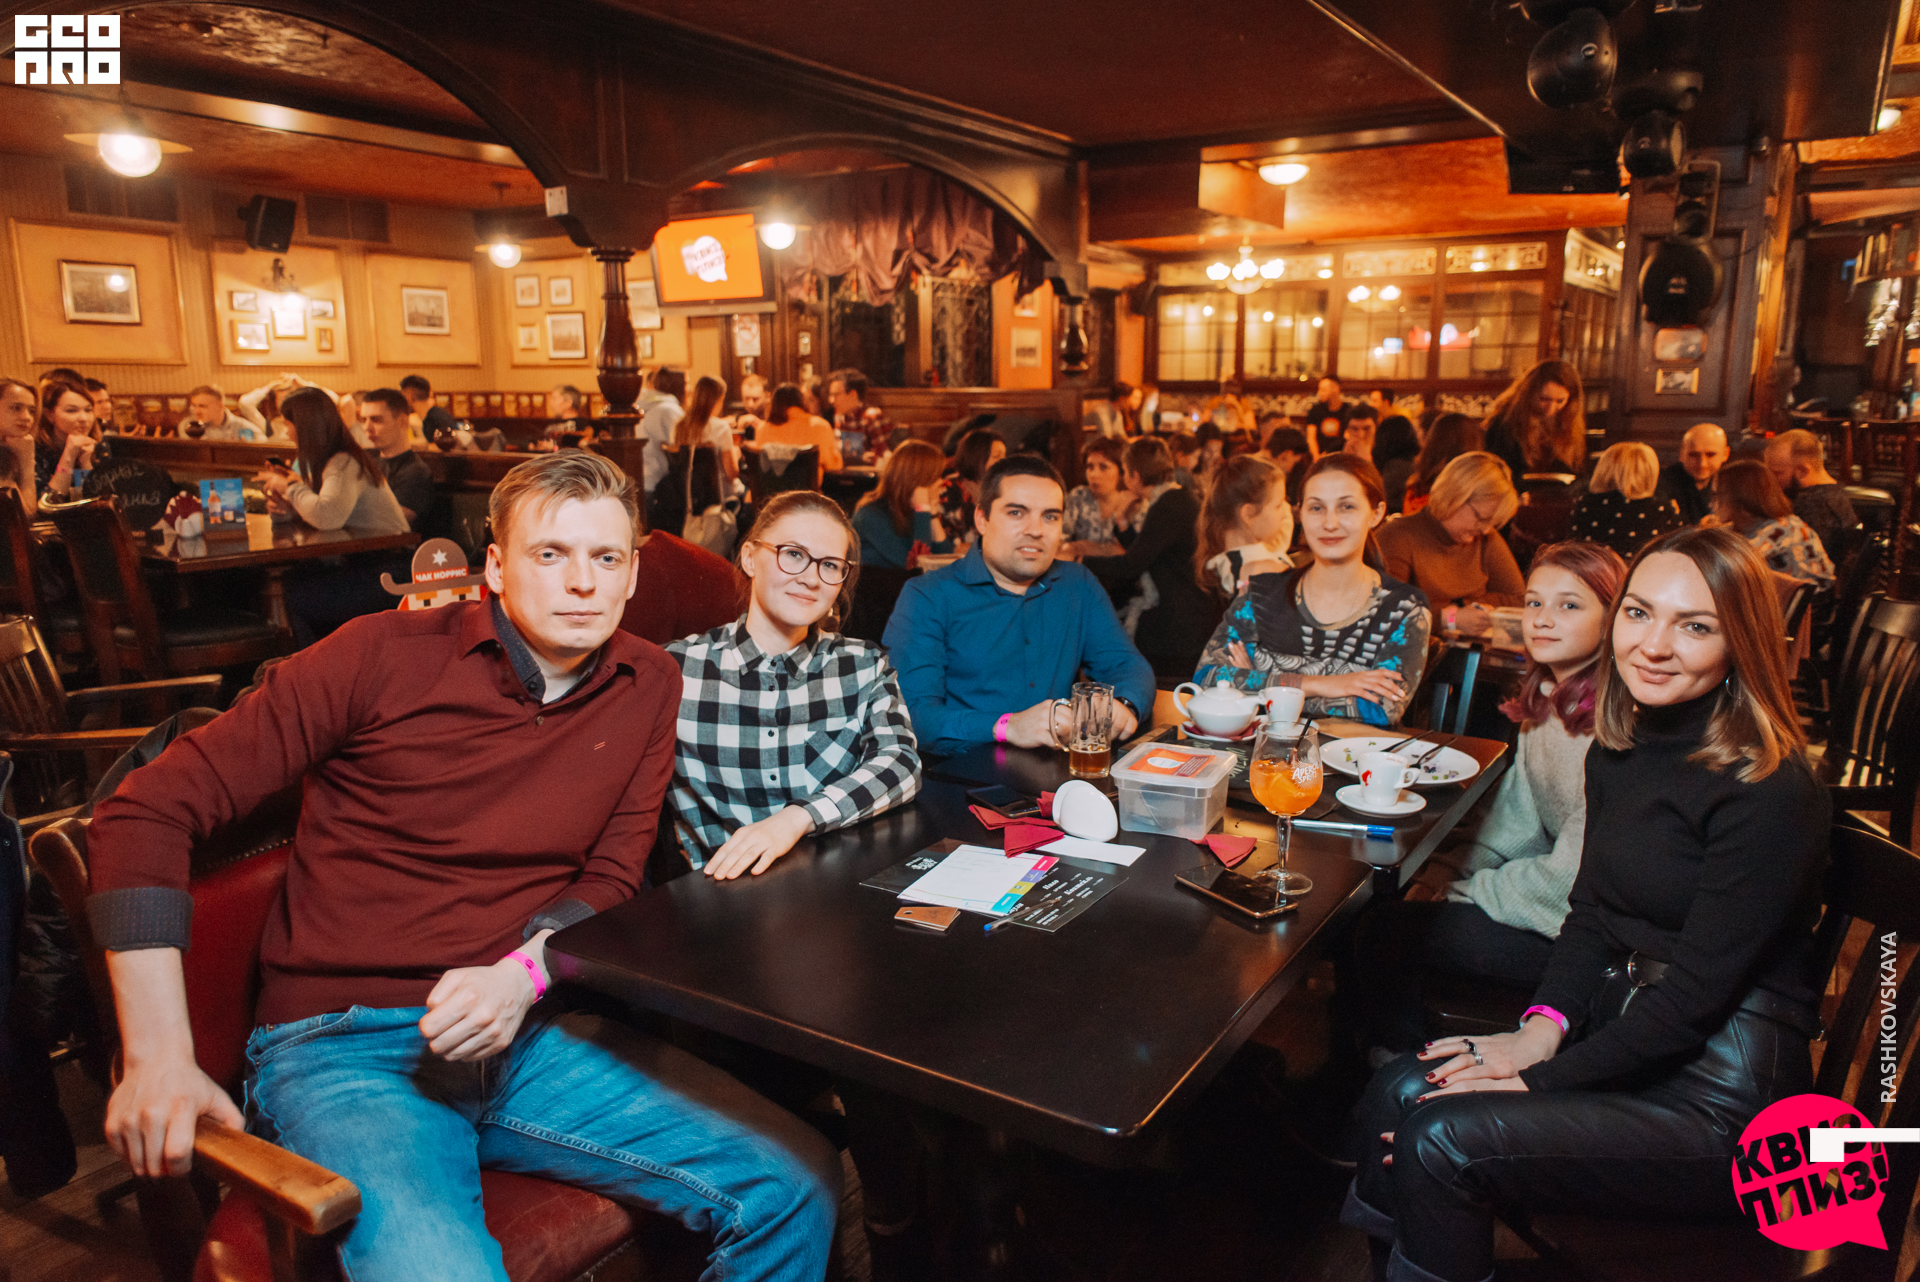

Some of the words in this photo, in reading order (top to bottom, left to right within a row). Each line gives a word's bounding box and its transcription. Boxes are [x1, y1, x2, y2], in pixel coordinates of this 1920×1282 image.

[415, 572, 433, 581] ЧАК
[434, 568, 467, 580] НОРРИС
[1292, 762, 1319, 780] APEROL
